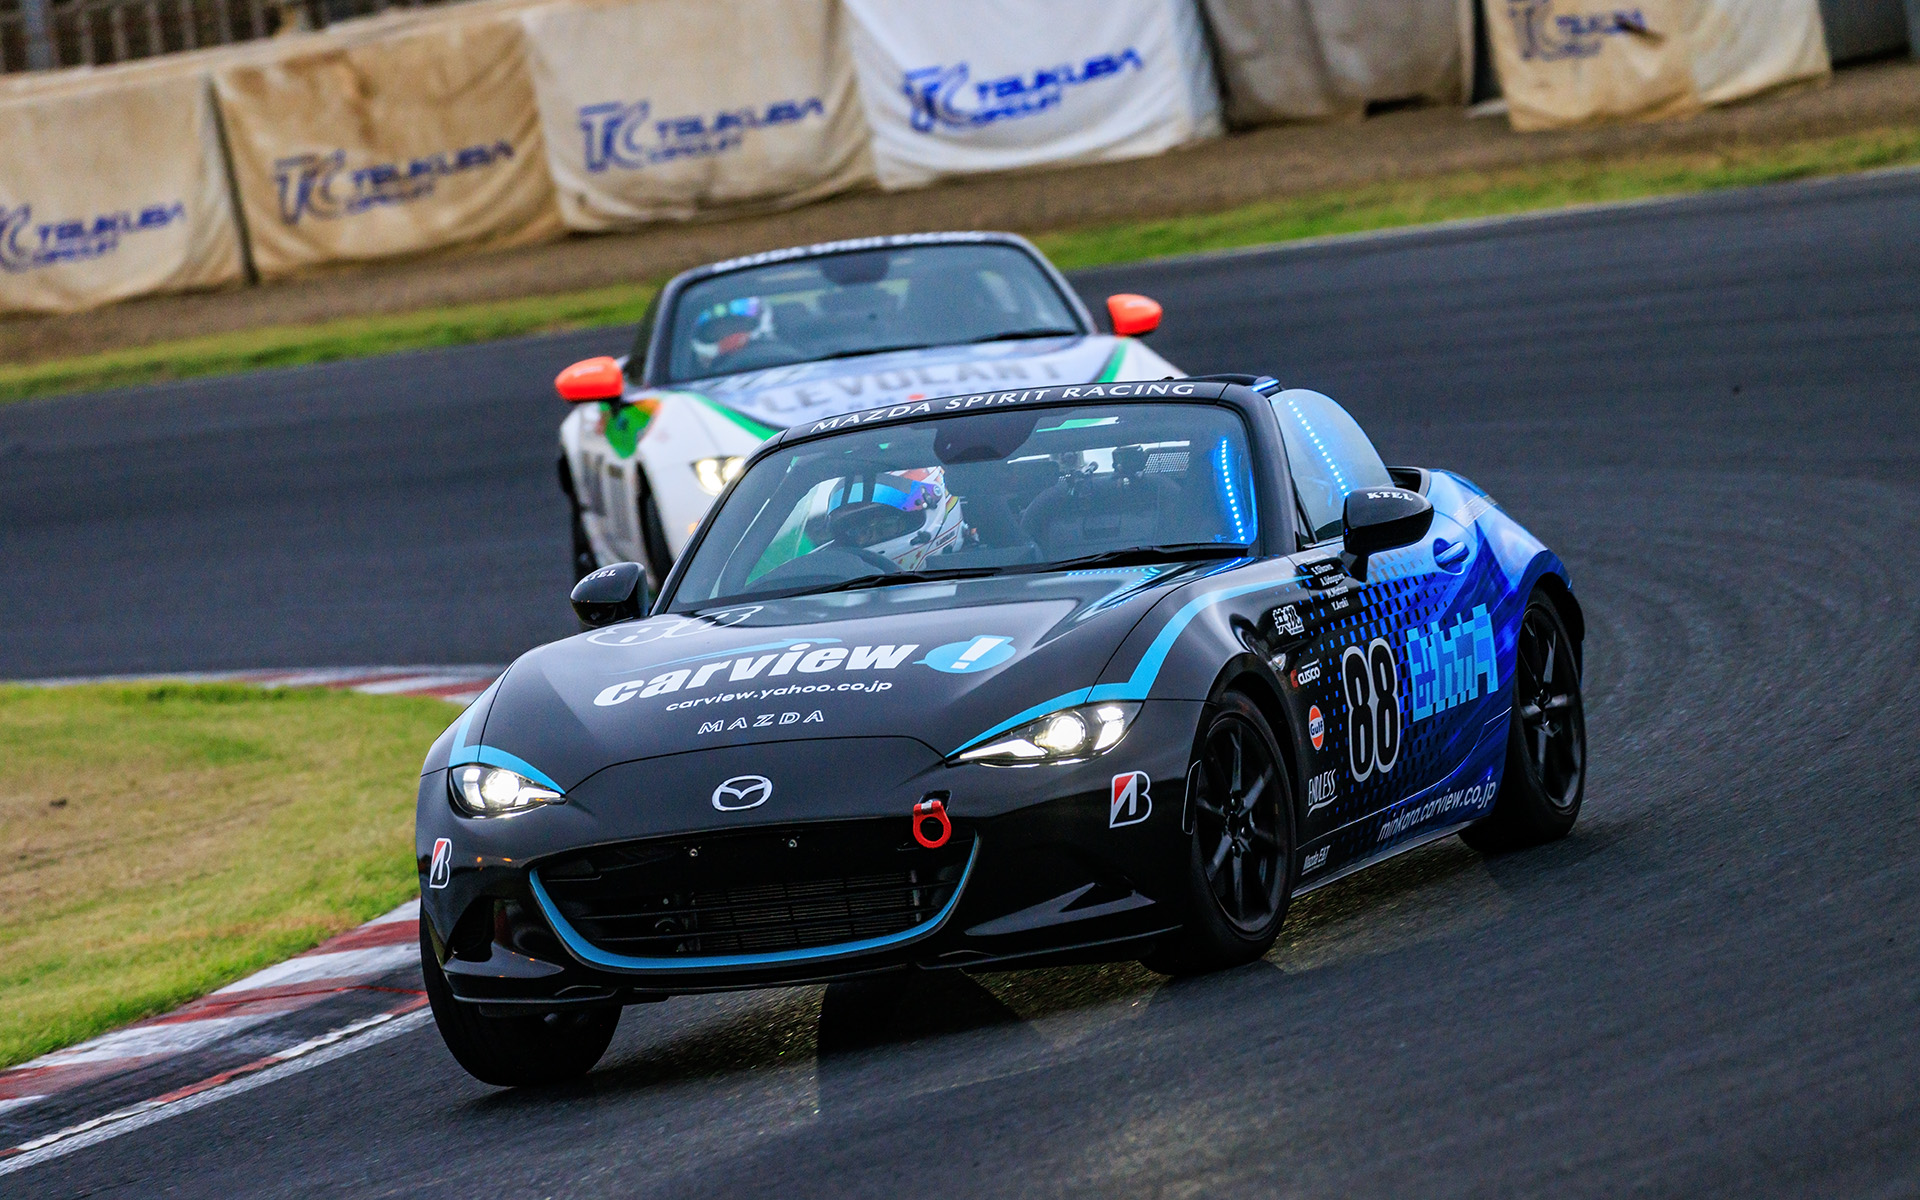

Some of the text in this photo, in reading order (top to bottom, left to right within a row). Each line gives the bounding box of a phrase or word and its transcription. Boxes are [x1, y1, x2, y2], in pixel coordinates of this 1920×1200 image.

[811, 404, 932, 433] MAZDA
[945, 390, 1051, 411] SPIRIT
[1062, 383, 1195, 398] RACING
[593, 643, 919, 707] carview
[665, 680, 893, 711] carview.yahoo.co.jp
[697, 710, 825, 735] MAZDA
[1309, 716, 1324, 736] Gulf
[1342, 637, 1401, 783] 88
[1307, 768, 1337, 807] ENDLESS
[1376, 775, 1496, 842] minkara.carview.co.jp
